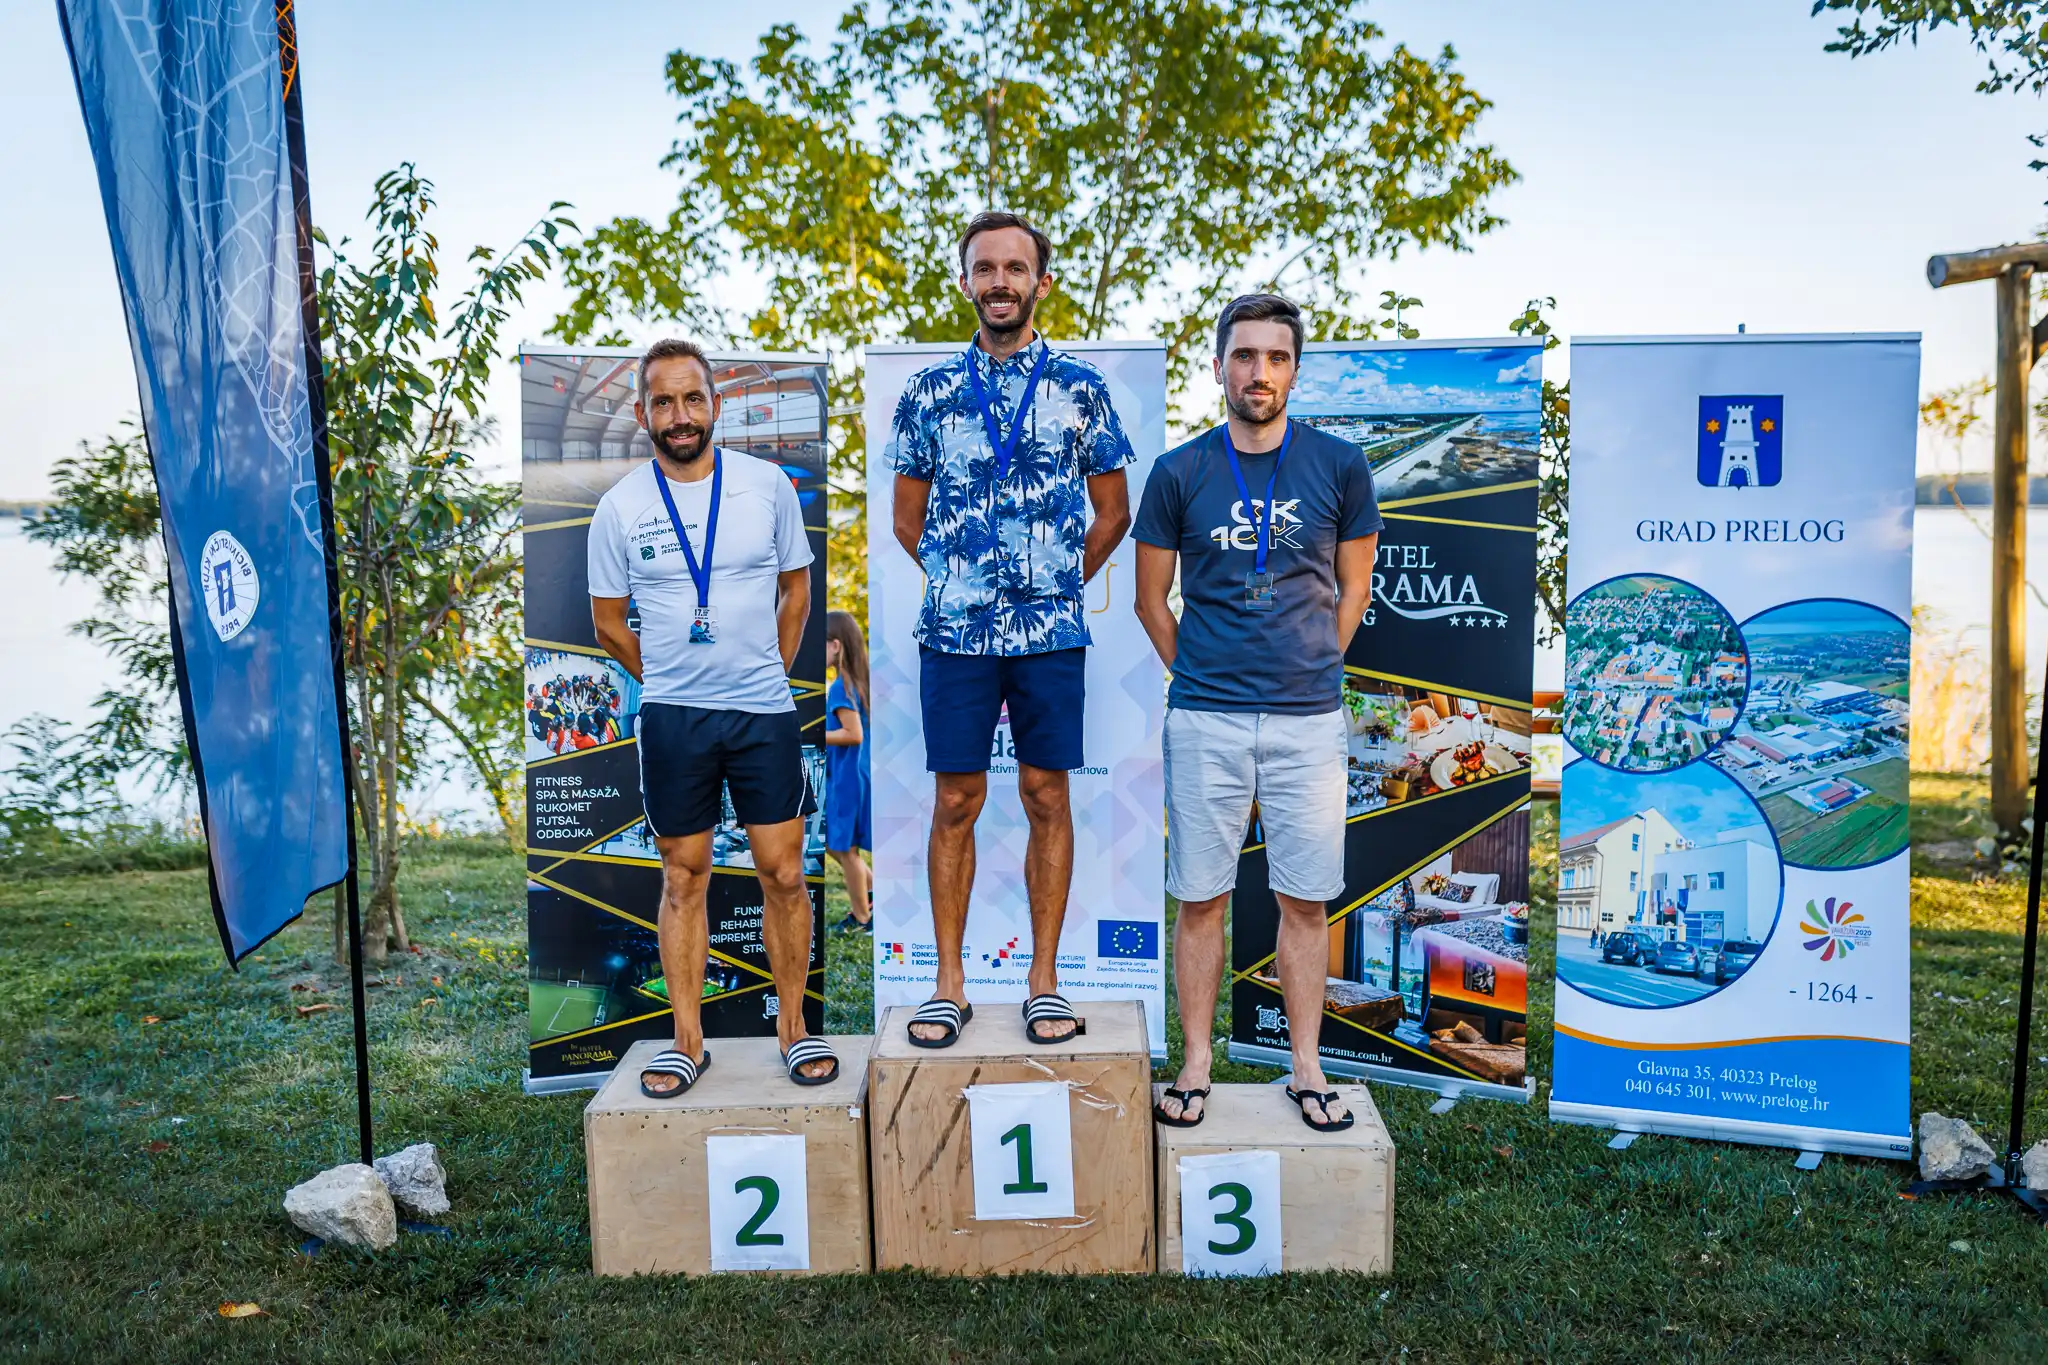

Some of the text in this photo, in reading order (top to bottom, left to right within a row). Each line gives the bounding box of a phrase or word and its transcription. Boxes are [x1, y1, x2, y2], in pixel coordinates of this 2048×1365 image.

[639, 529, 668, 540] PLITVIČKI
[1636, 519, 1845, 542] GRAD PRELOG
[1373, 545, 1436, 568] TEL
[1369, 573, 1484, 605] RAMA
[535, 776, 583, 787] FITNESS
[535, 785, 621, 800] SPA & MASAŽA
[536, 801, 593, 813] RUKOMET
[536, 815, 581, 826] FUTSAL
[536, 828, 595, 840] ODBOJKA
[1855, 929, 1872, 937] 2020
[880, 974, 907, 983] Projekt
[998, 977, 1016, 985] unija
[1064, 980, 1086, 988] fonda
[1096, 981, 1134, 992] regionalni
[1134, 983, 1160, 991] razvoj.
[1807, 981, 1858, 1004] 1264
[562, 1050, 613, 1062] PANORAMA
[1637, 1060, 1818, 1094] Glavna 35, 40323 Prelog
[1624, 1078, 1830, 1113] 040 645 301, www.prelog.hr
[1000, 1123, 1048, 1195] 1
[735, 1175, 784, 1247] 2
[1208, 1182, 1257, 1256] 3
